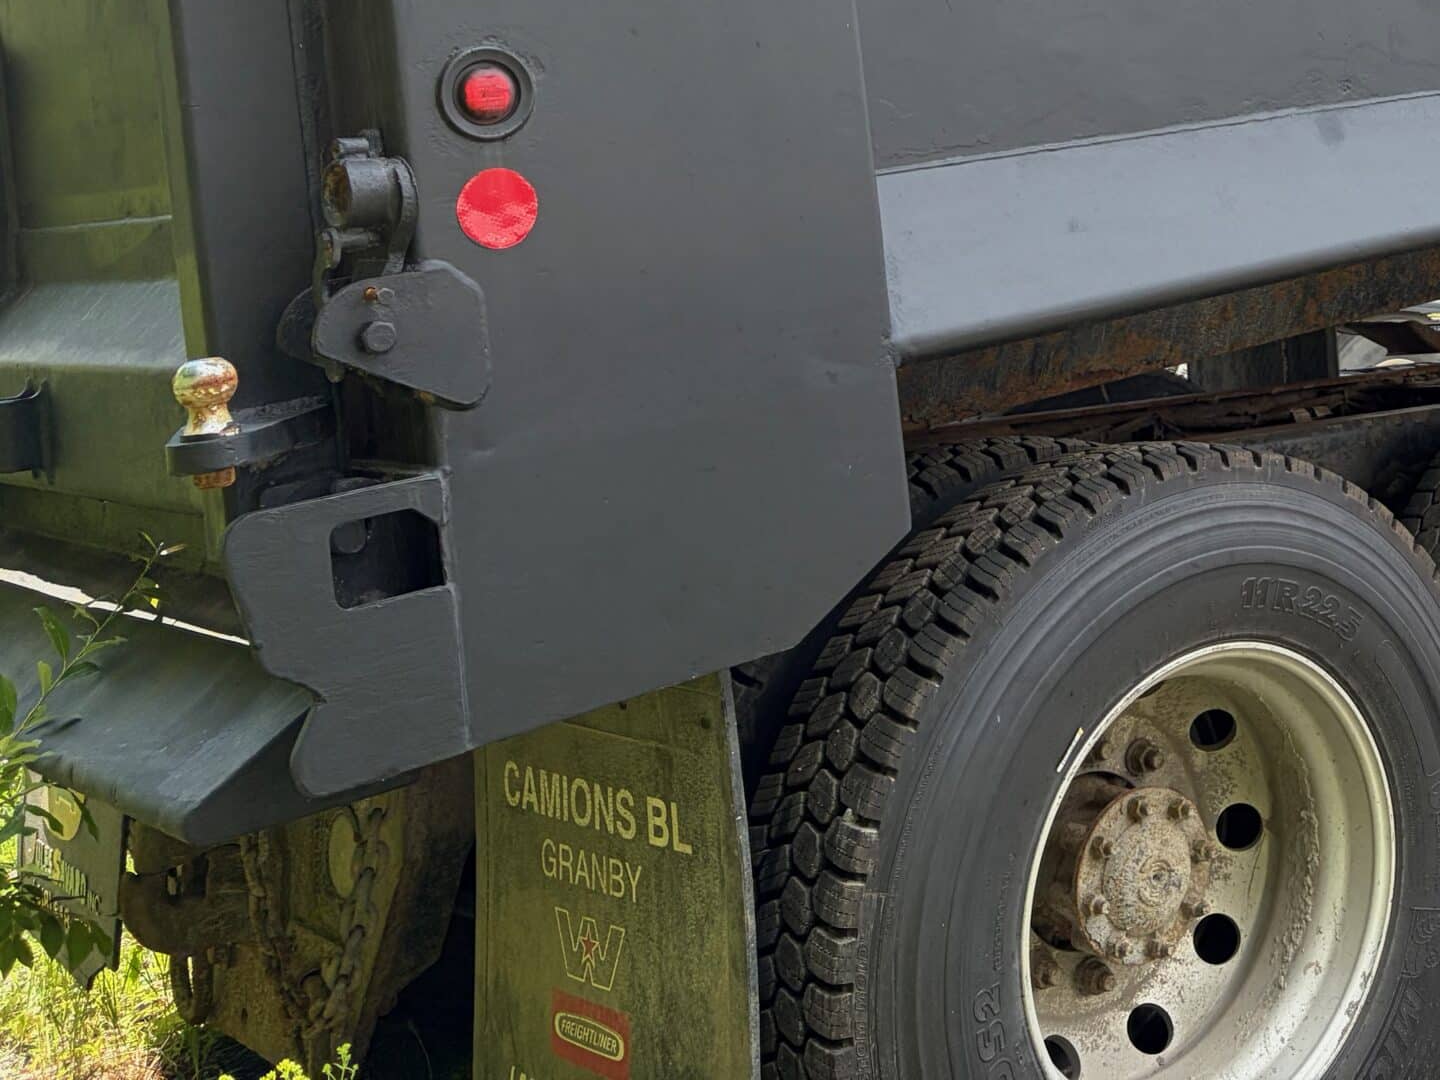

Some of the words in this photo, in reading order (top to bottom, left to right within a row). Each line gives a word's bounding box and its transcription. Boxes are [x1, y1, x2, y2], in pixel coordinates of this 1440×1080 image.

[503, 760, 637, 841] CAMIONS
[646, 795, 693, 856] BL
[541, 838, 642, 903] GRANBY
[560, 1019, 618, 1054] FREIGHTLINER
